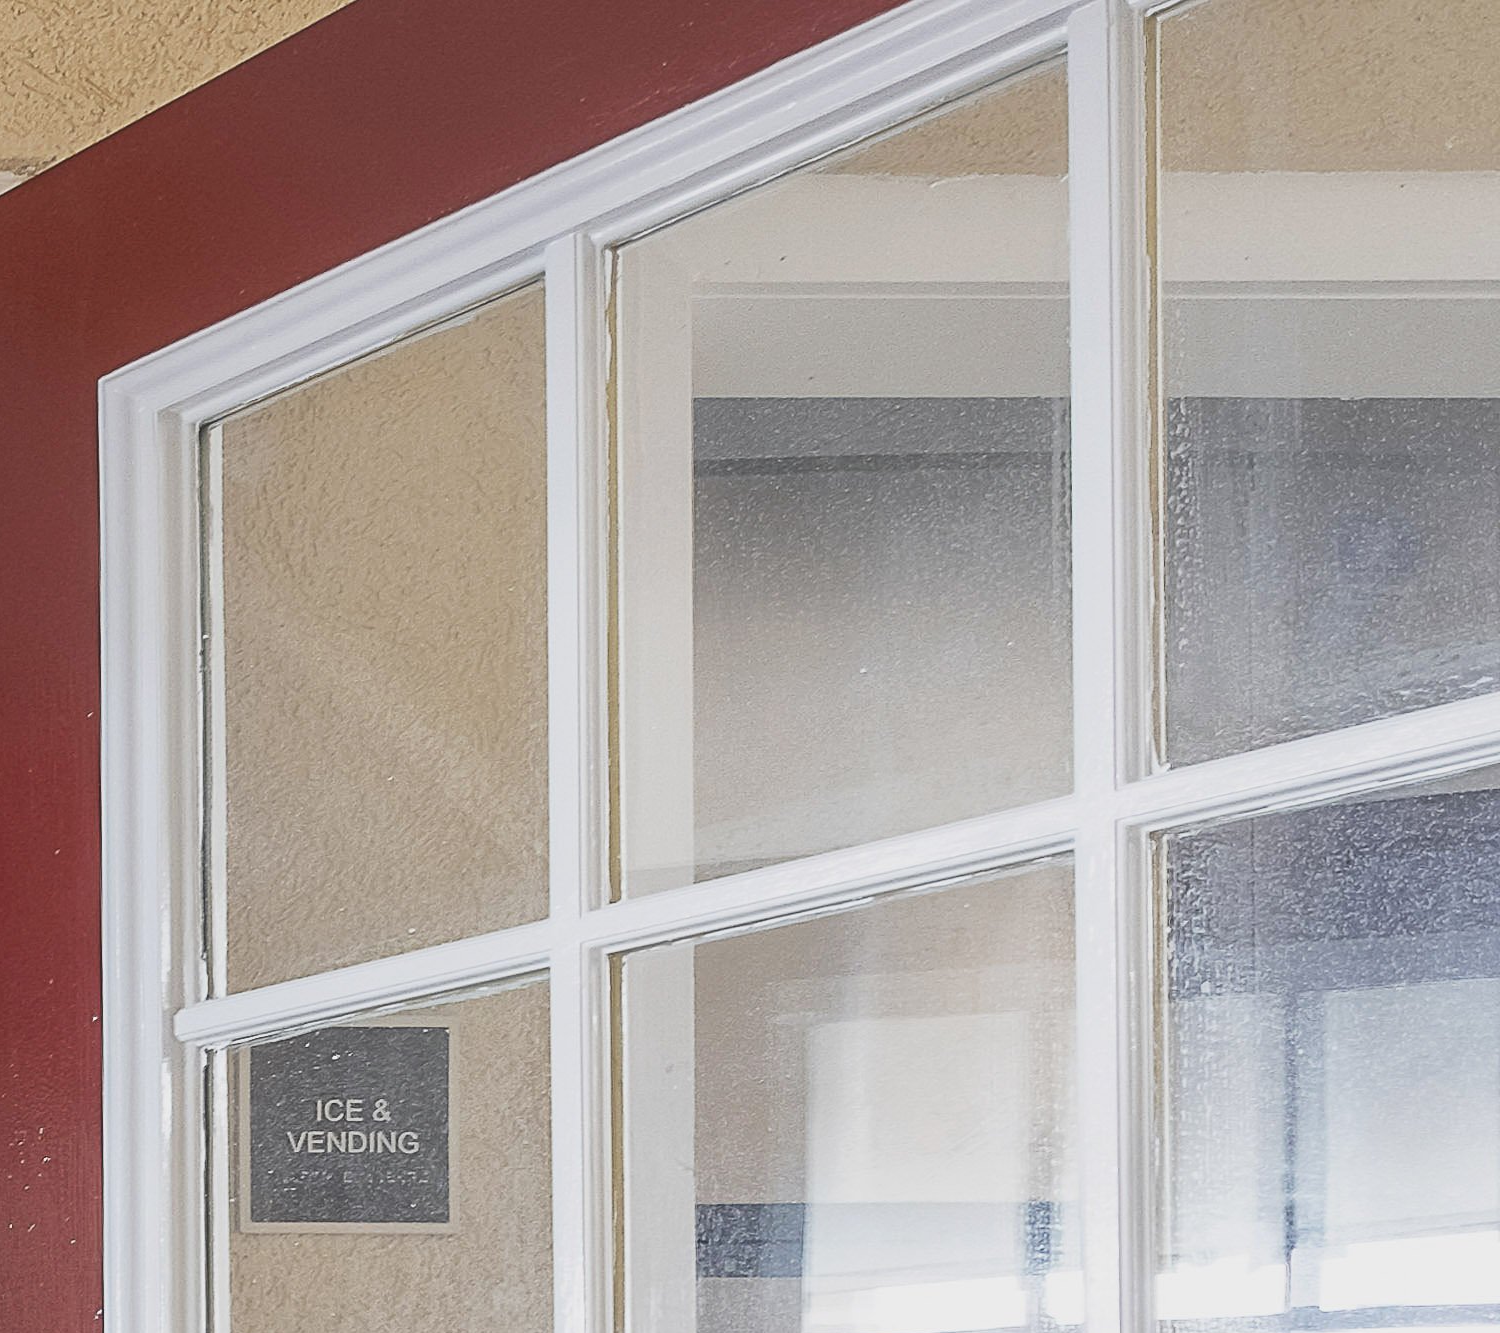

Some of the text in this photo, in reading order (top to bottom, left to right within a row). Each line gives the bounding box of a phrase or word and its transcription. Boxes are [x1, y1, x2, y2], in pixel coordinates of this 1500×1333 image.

[315, 1098, 392, 1123] ICE &
[286, 1130, 421, 1155] VENDING
